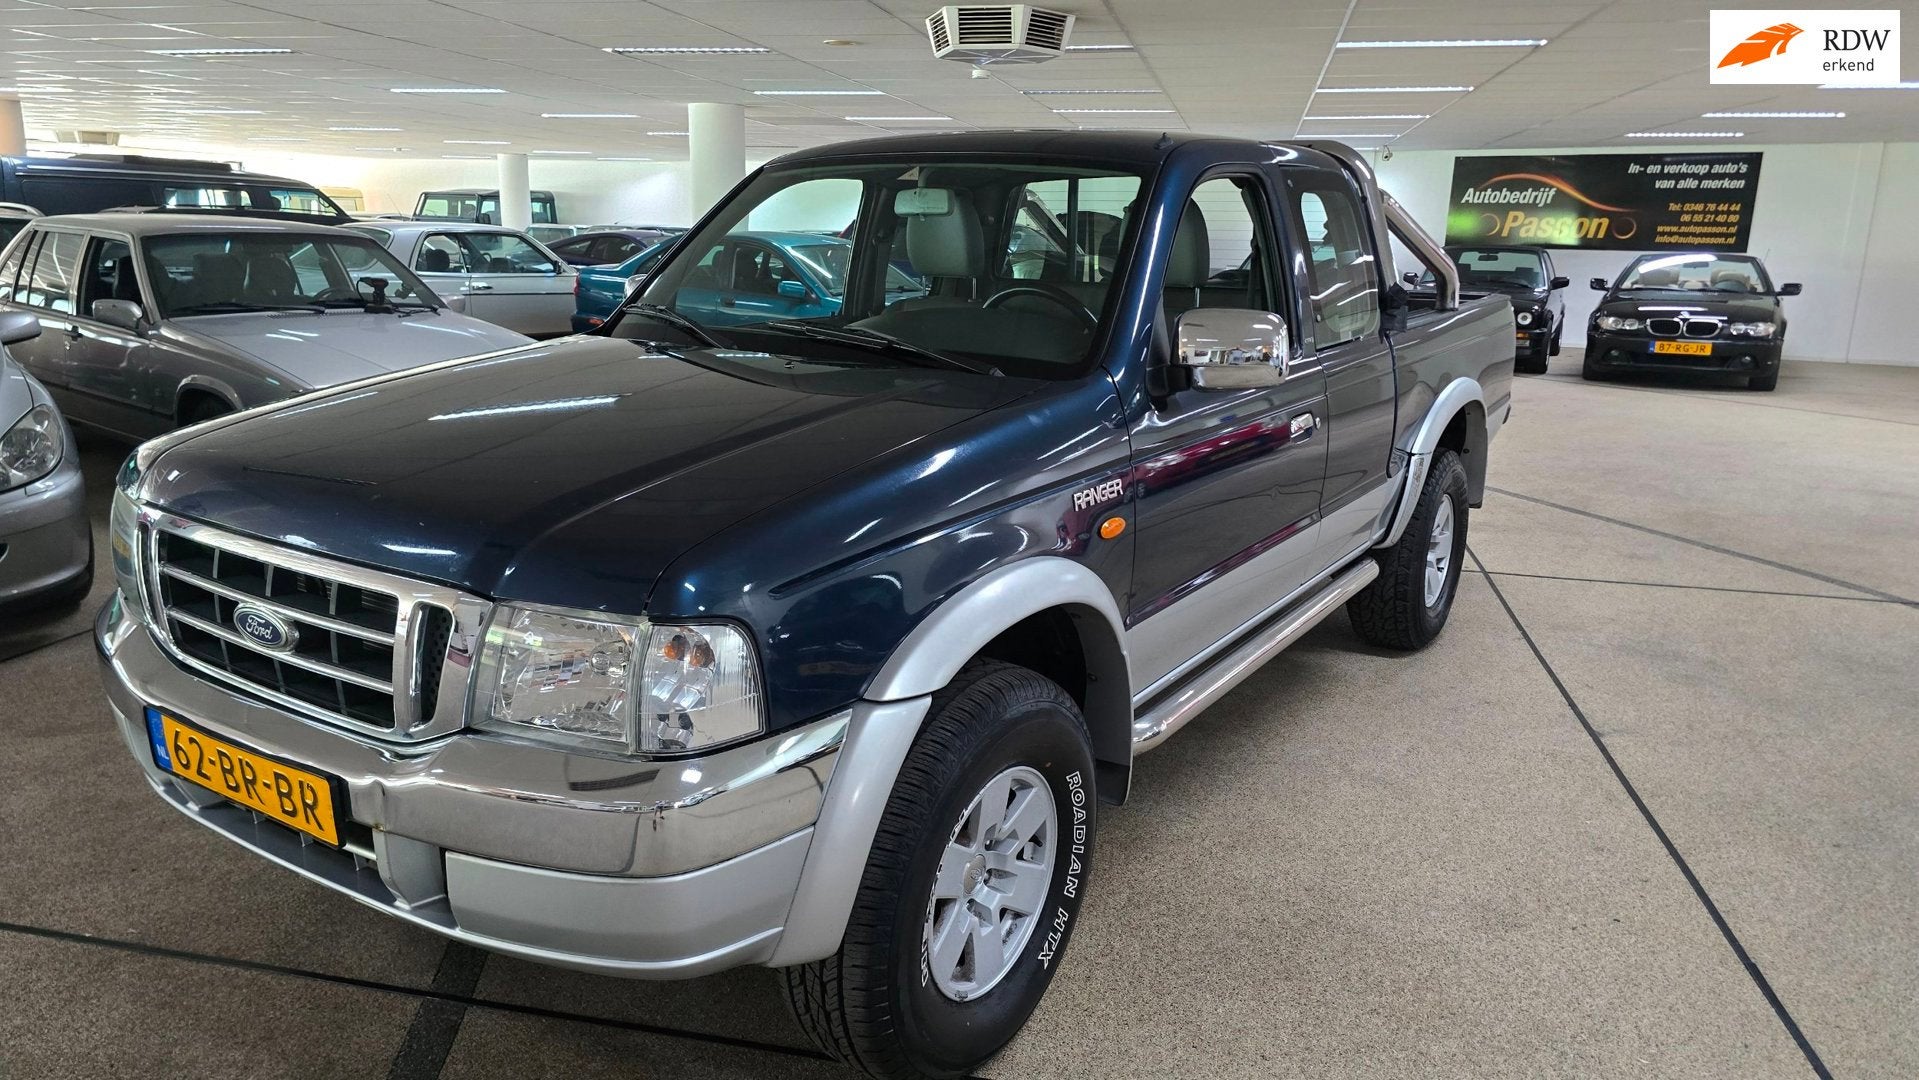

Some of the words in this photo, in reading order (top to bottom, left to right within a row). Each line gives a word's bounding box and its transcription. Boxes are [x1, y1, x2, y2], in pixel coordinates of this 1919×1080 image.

[1628, 163, 1645, 174] In-
[1646, 165, 1662, 174] en
[1663, 163, 1710, 176] verkoop
[1711, 162, 1749, 174] auto's
[1655, 179, 1676, 189] van
[1676, 178, 1700, 189] alle
[1700, 178, 1746, 189] merken
[1461, 187, 1557, 208] Autobedrijf
[1717, 203, 1729, 212] 44
[1730, 203, 1742, 212] 44
[1501, 210, 1610, 239] Passon
[1680, 214, 1692, 222] 06
[1704, 214, 1715, 222] 21
[1715, 214, 1727, 222] 40
[1657, 225, 1738, 234] www.autopasson.nl
[1655, 235, 1737, 245] info@autopasson.nl
[1658, 343, 1706, 353] 87-RG-JR
[1073, 478, 1124, 512] RANGER
[245, 614, 273, 640] Ford
[156, 743, 170, 760] NL
[172, 727, 325, 832] 62-BR-BR
[1064, 770, 1087, 898] ROADIAN
[1037, 906, 1069, 970] HTX
